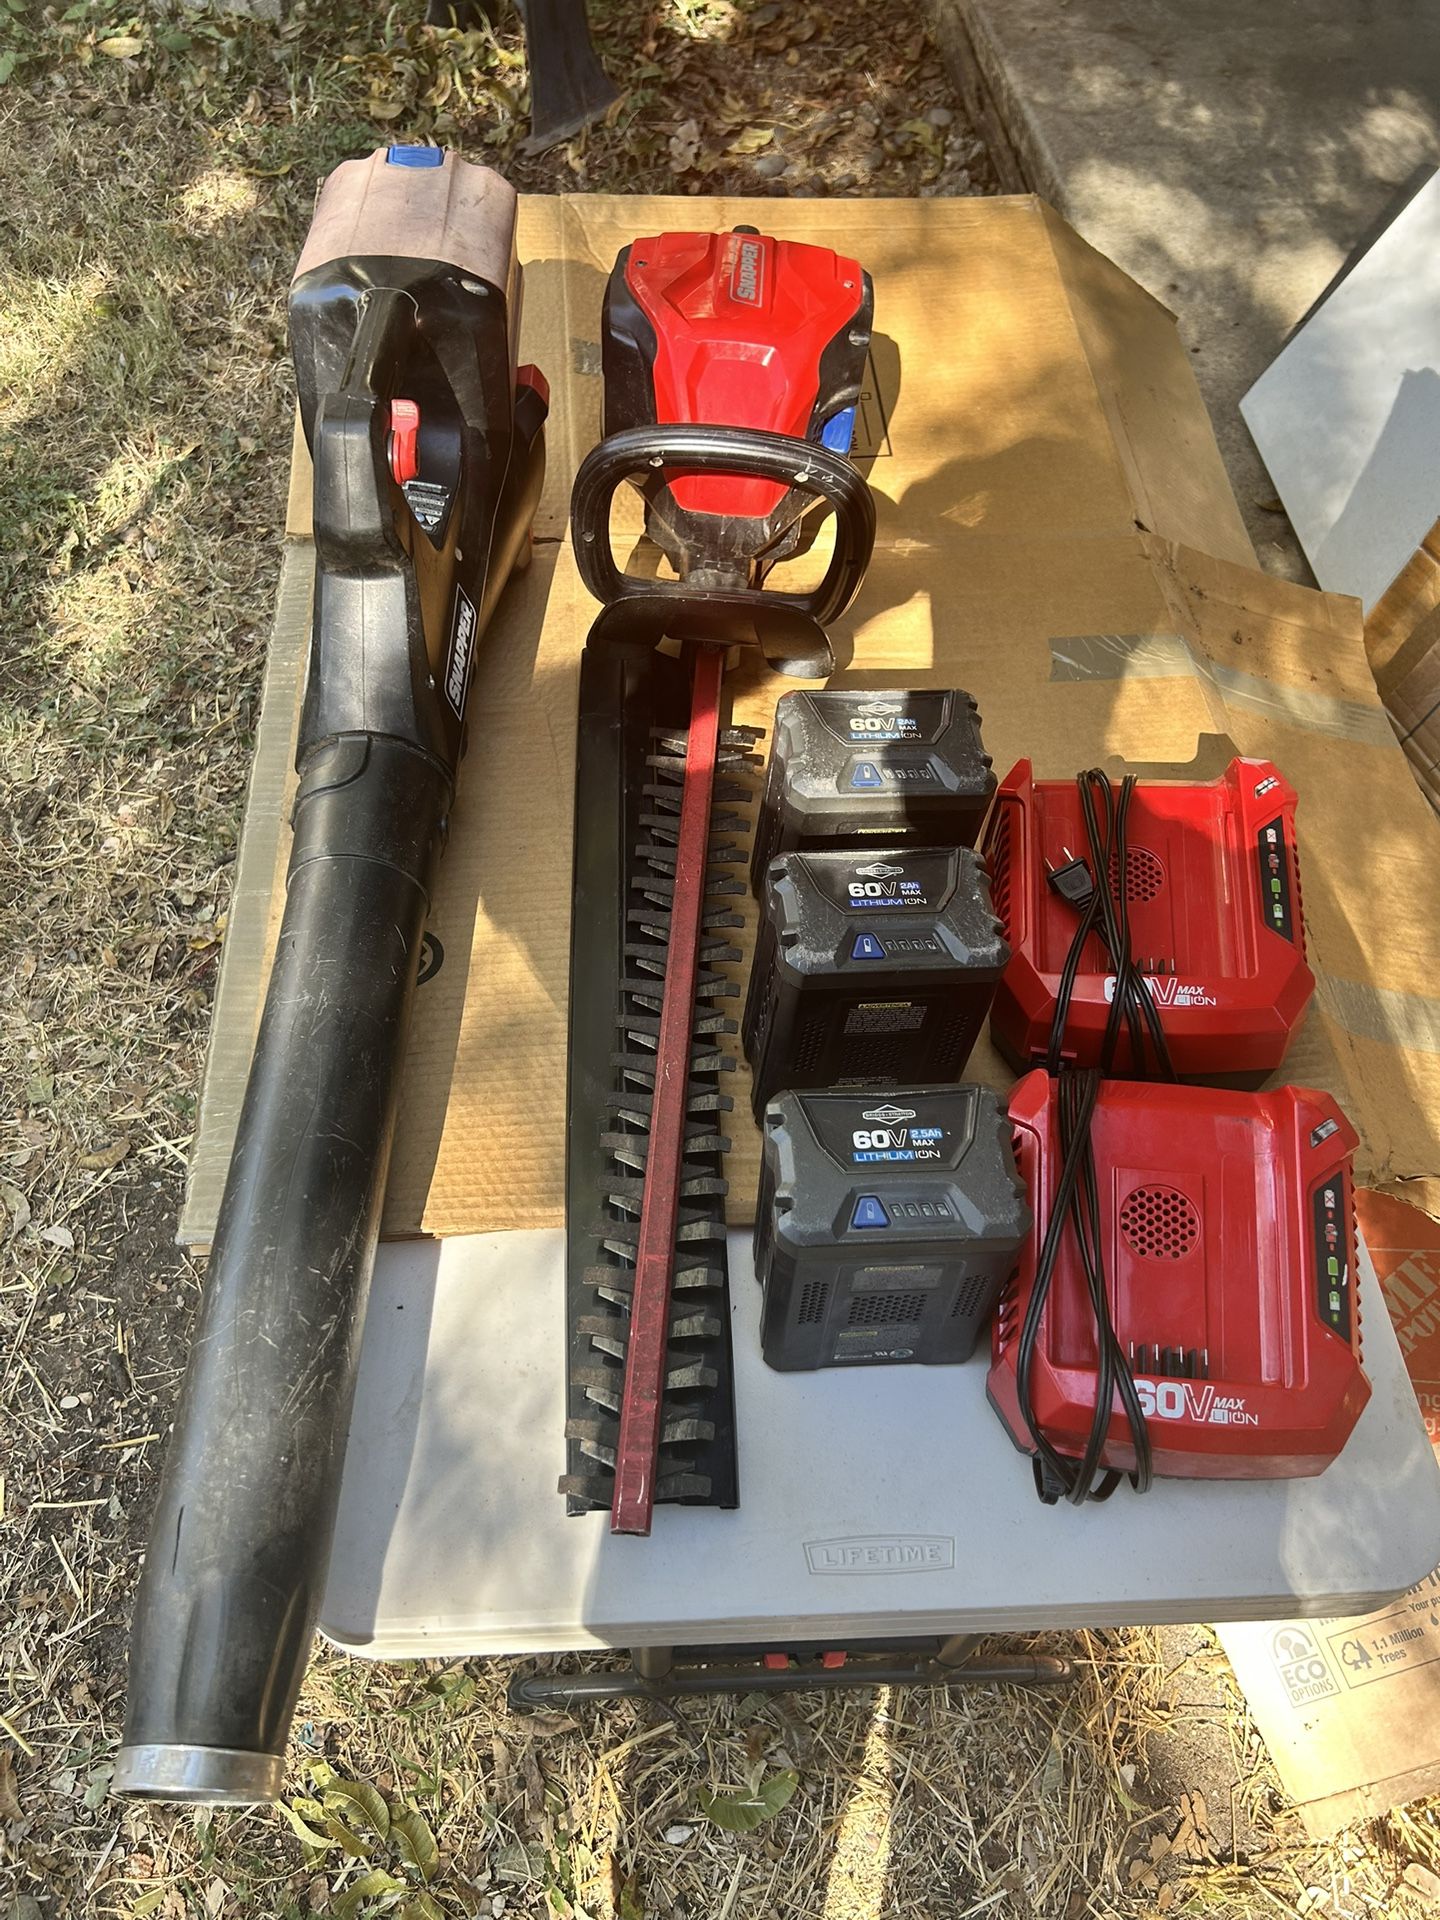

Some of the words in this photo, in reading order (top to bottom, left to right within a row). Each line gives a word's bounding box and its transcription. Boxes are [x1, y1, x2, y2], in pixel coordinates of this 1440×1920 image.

[737, 242, 759, 300] SNAPPER
[449, 600, 472, 707] SNAPPER
[849, 717, 896, 731] 60V
[848, 881, 897, 897] 60V
[850, 899, 904, 907] LITHIUM
[1177, 986, 1204, 995] MAX
[853, 1129, 908, 1149] 60V
[910, 1129, 942, 1138] 2.5Ah
[912, 1139, 935, 1147] MAX
[854, 1151, 914, 1162] LITHIUM
[1132, 1379, 1215, 1422] 60V
[1213, 1396, 1246, 1410] MAX
[823, 1544, 942, 1566] LIFETIME
[1408, 1599, 1430, 1612] Your
[1371, 1637, 1388, 1651] 1.1
[1389, 1626, 1425, 1646] Million
[1377, 1649, 1407, 1665] Trees
[1282, 1660, 1327, 1688] ECO
[1292, 1678, 1334, 1702] OPTIONS
